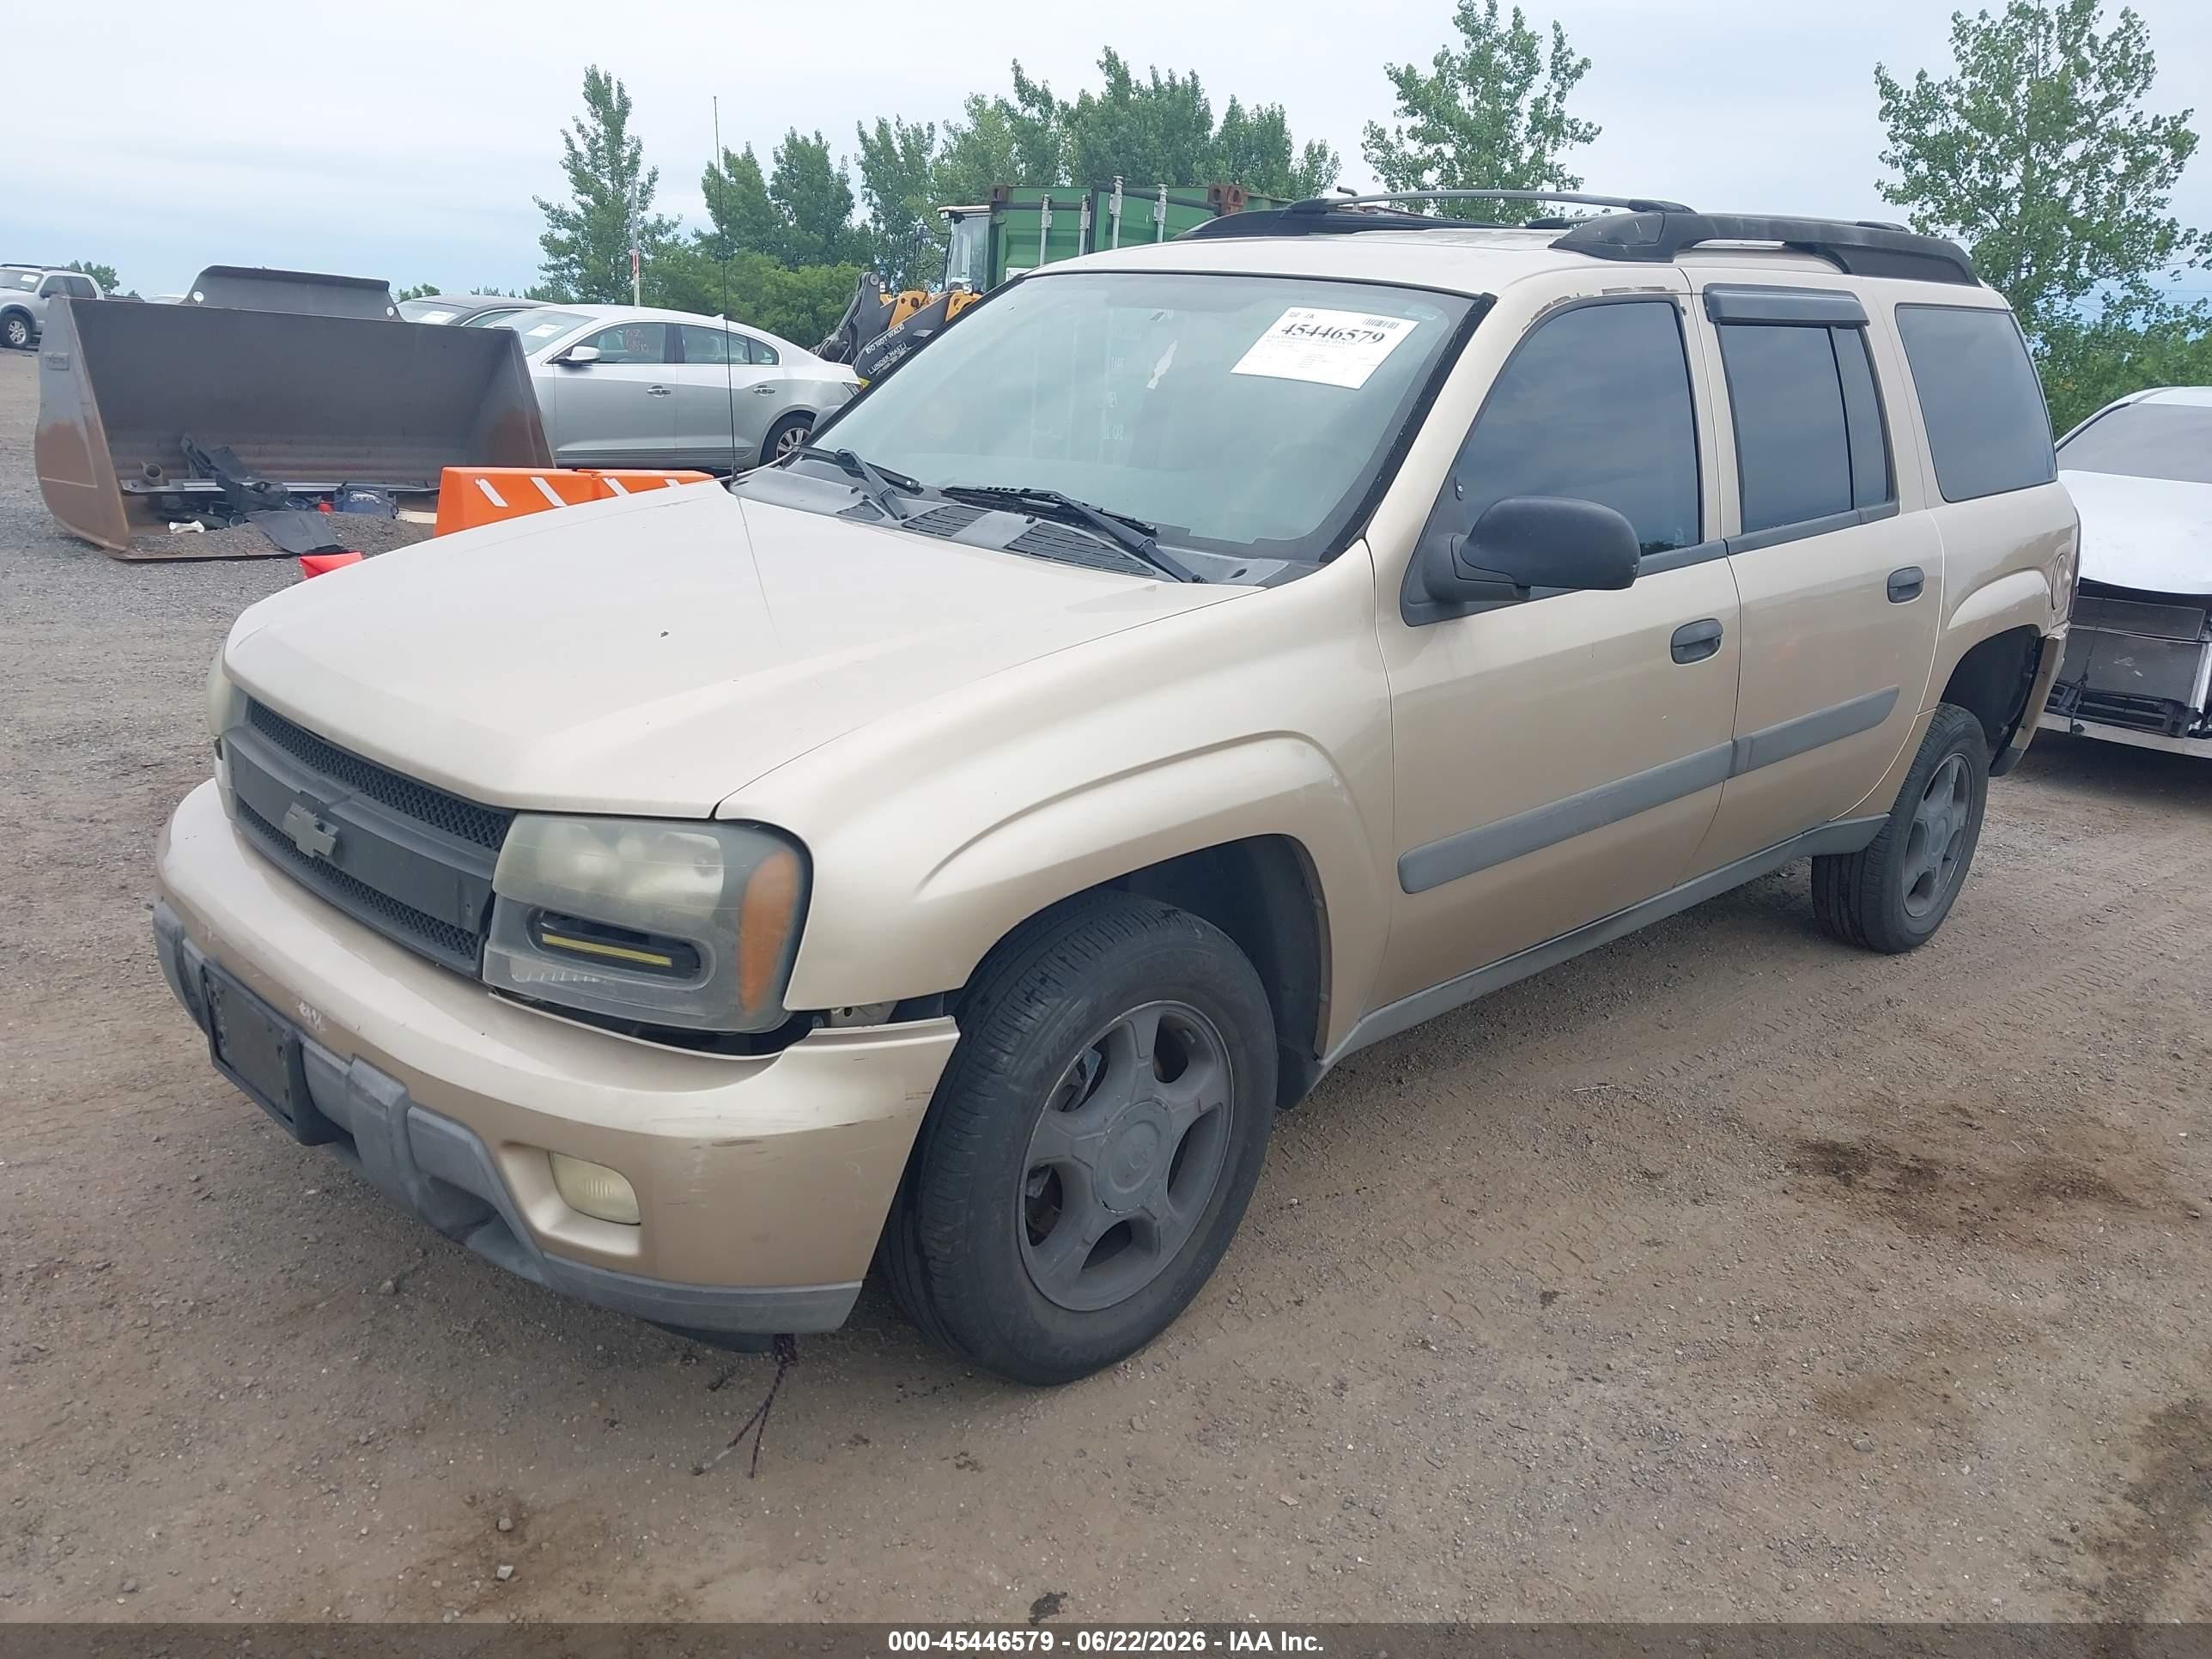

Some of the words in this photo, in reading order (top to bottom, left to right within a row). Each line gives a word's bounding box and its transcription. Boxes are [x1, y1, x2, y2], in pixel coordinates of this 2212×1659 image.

[866, 344, 875, 355] DO
[875, 337, 888, 348] NOT
[887, 324, 904, 338] WALK
[1281, 323, 1386, 344] 45446579
[871, 354, 890, 370] UNDER
[890, 343, 904, 357] MAST
